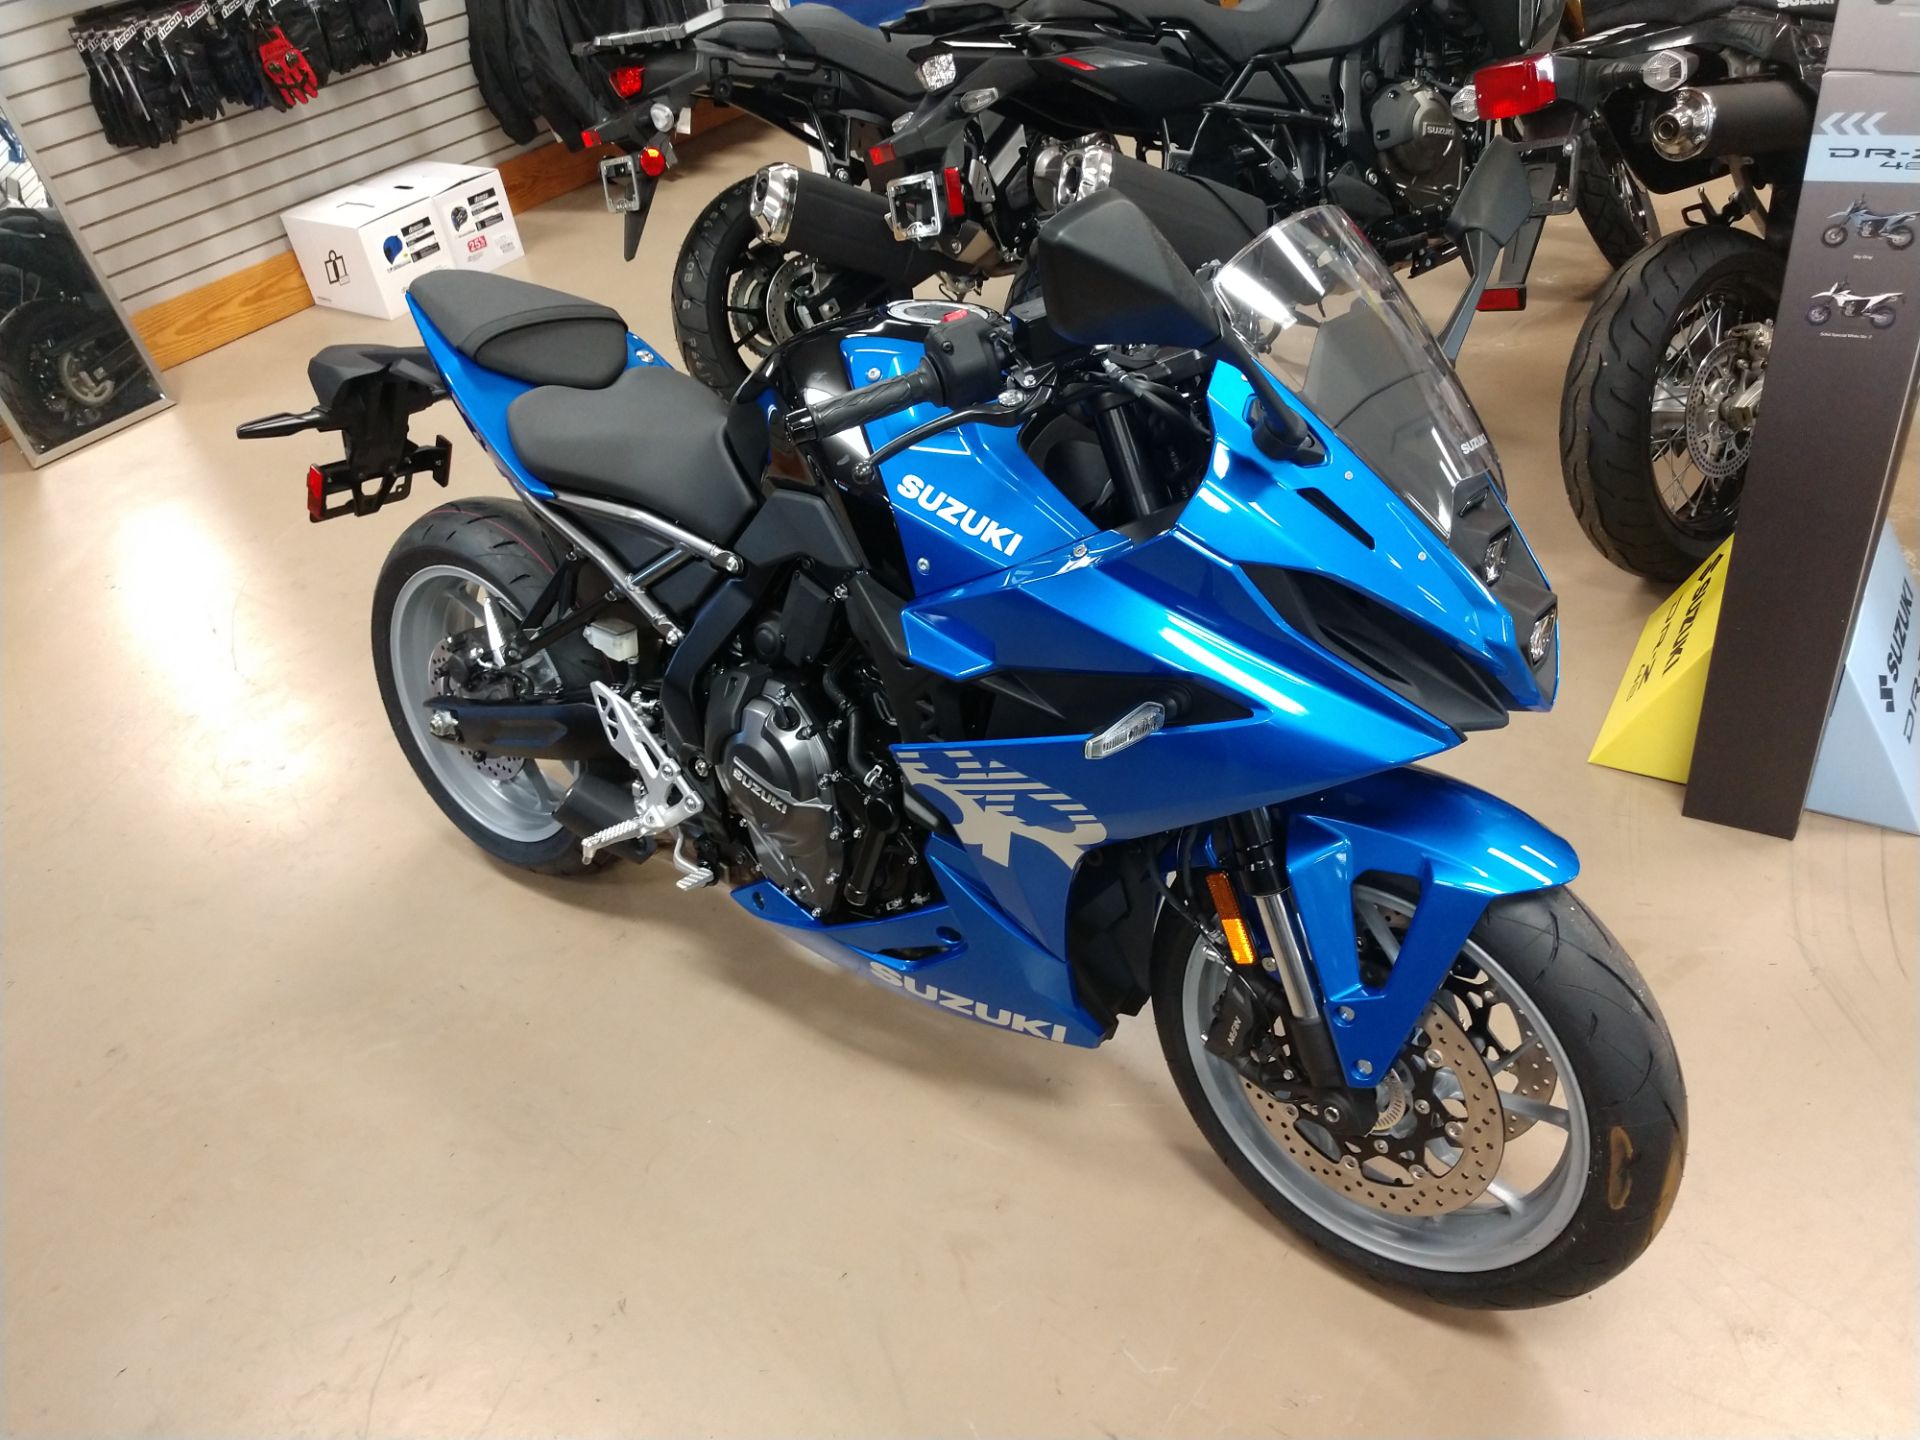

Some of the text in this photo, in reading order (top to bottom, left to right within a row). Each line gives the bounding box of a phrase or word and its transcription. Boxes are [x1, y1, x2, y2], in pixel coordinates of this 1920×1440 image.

[1461, 433, 1488, 454] SUZUKI
[896, 473, 1024, 557] SUZUKI
[1661, 576, 1711, 677] SUZUKI
[1887, 577, 1914, 684] SUZUKI
[732, 768, 788, 815] SUZUKI
[870, 961, 1067, 1043] SUZUKI
